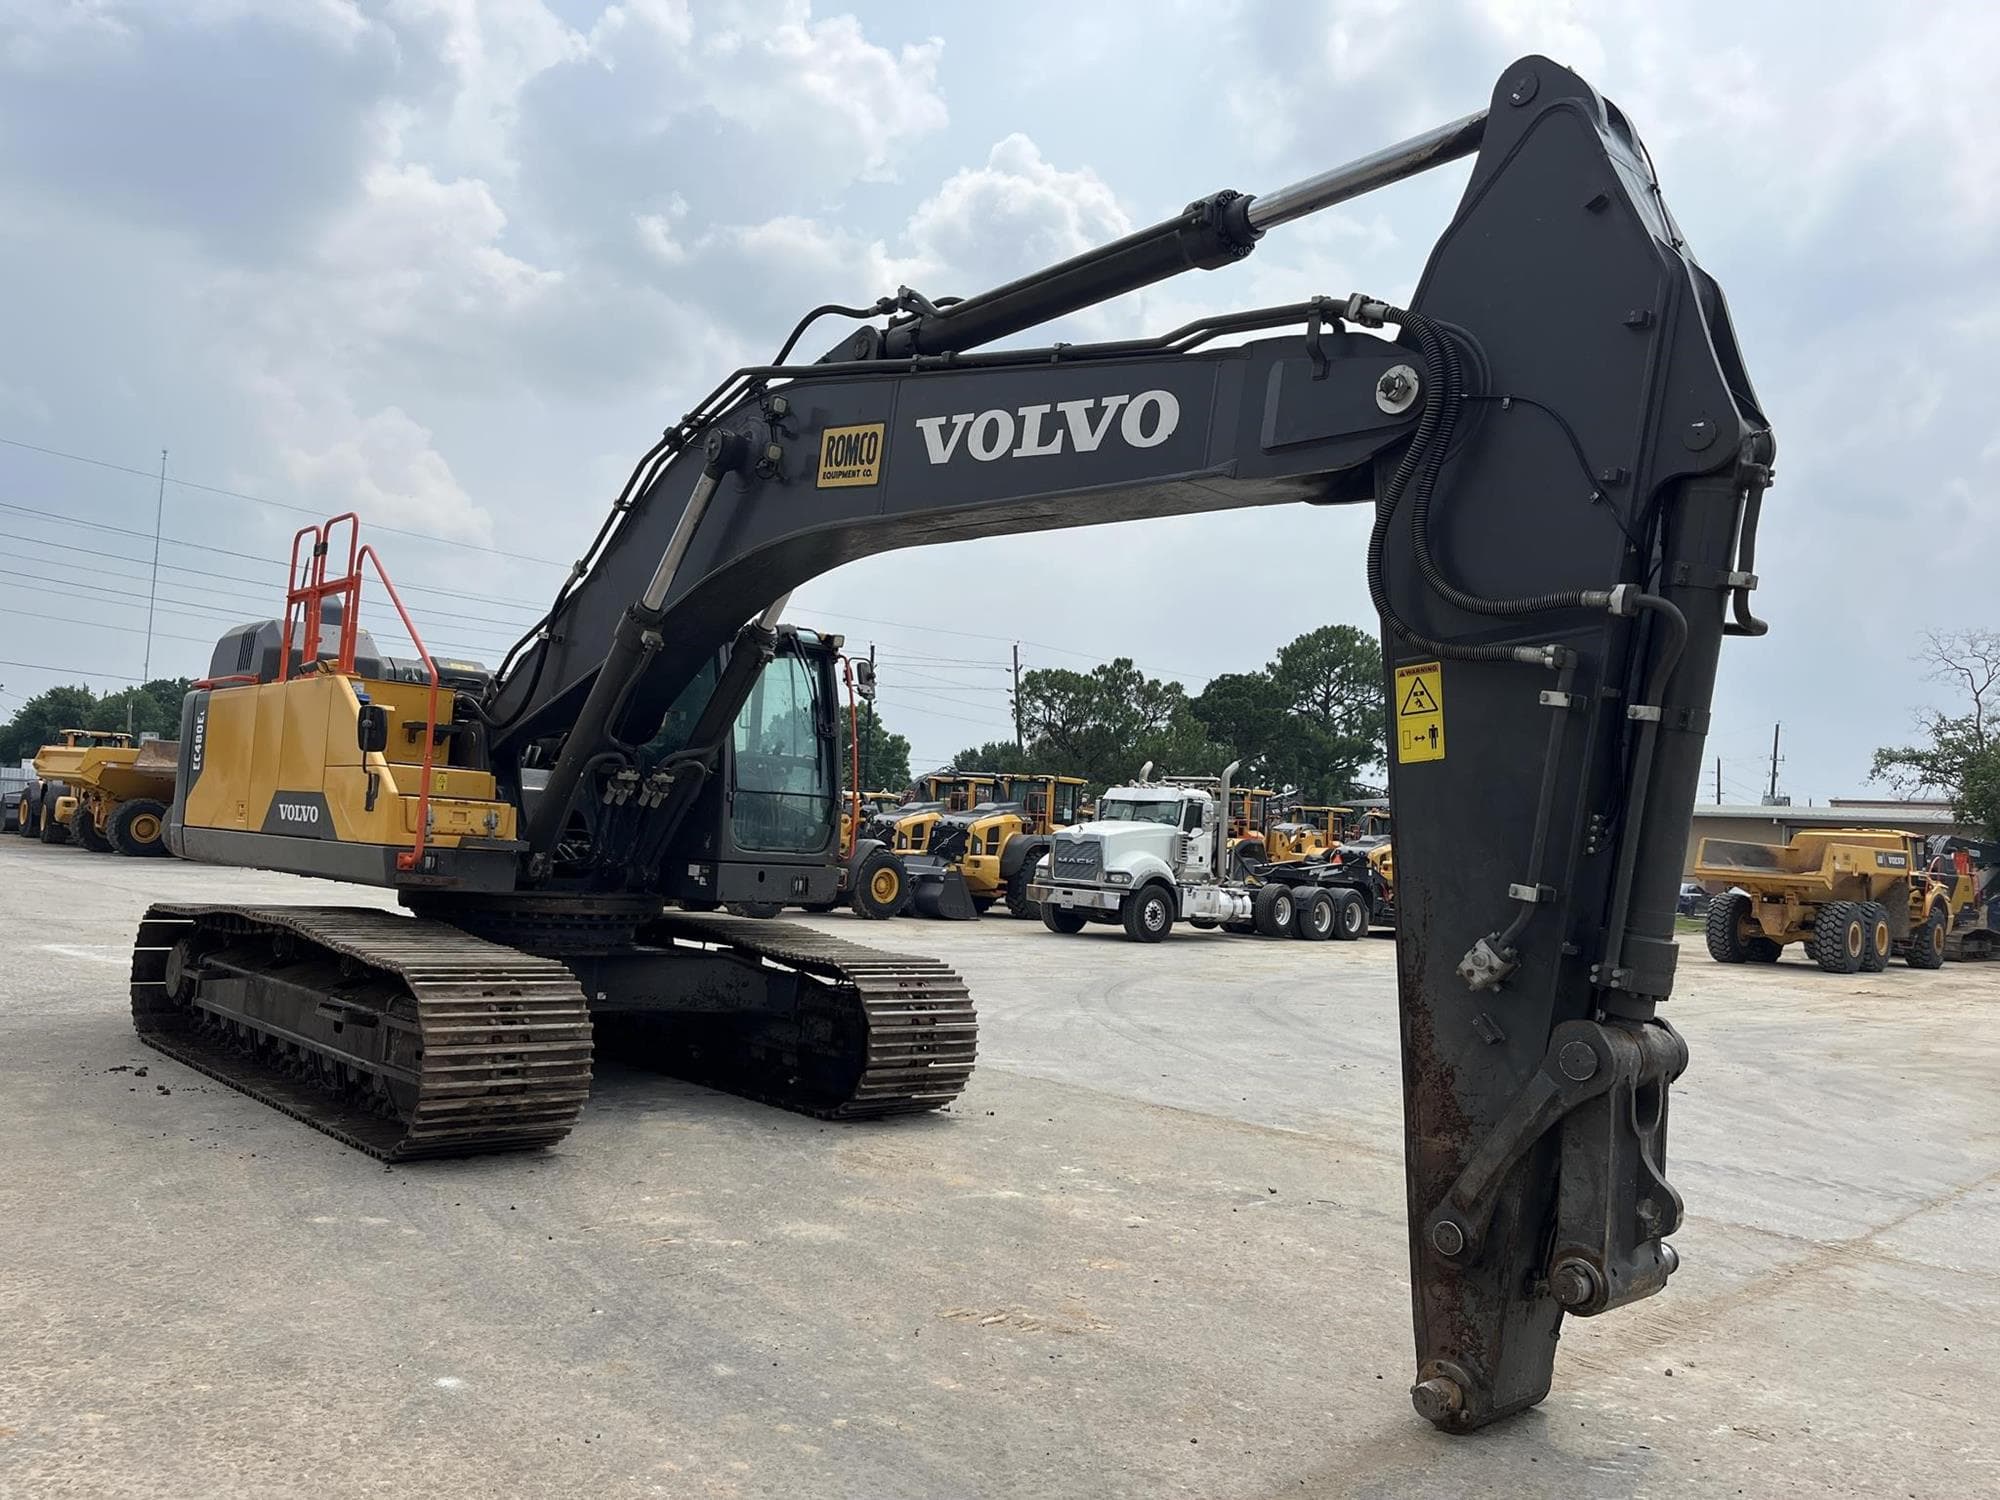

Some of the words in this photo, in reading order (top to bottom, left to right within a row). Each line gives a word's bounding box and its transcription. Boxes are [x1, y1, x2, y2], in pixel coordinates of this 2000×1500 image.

[916, 390, 1180, 464] VOLVO
[824, 431, 878, 468] ROMCO
[823, 469, 861, 480] EQUIPMENT
[863, 469, 873, 477] CO.
[279, 804, 319, 823] VOLVO
